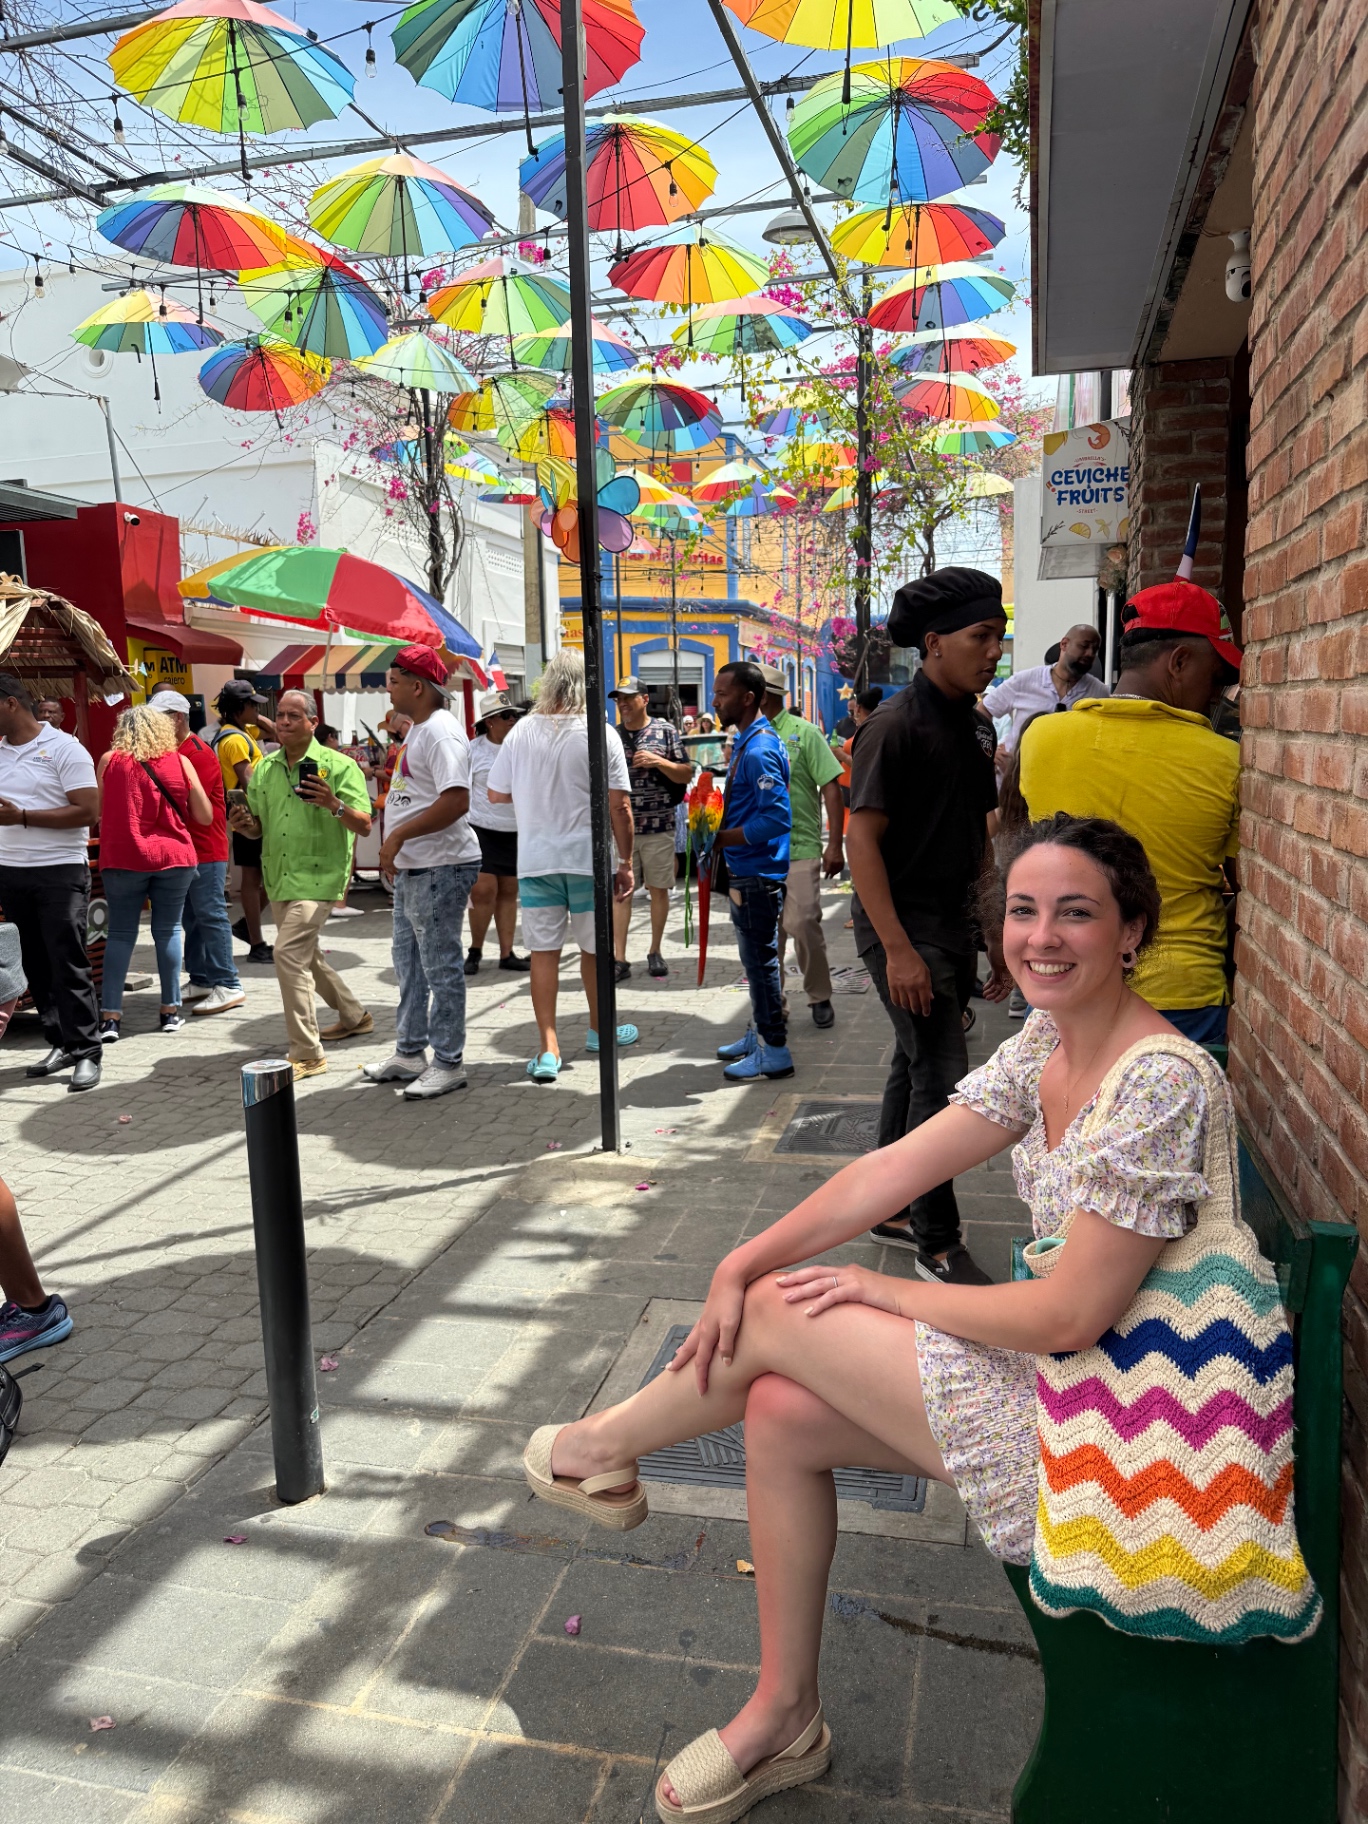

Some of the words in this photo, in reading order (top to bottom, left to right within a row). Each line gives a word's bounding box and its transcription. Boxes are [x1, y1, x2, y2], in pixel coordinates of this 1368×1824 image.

[1051, 466, 1130, 486] CEVICHE
[1056, 486, 1125, 506] FRUITS
[160, 656, 188, 673] ATM
